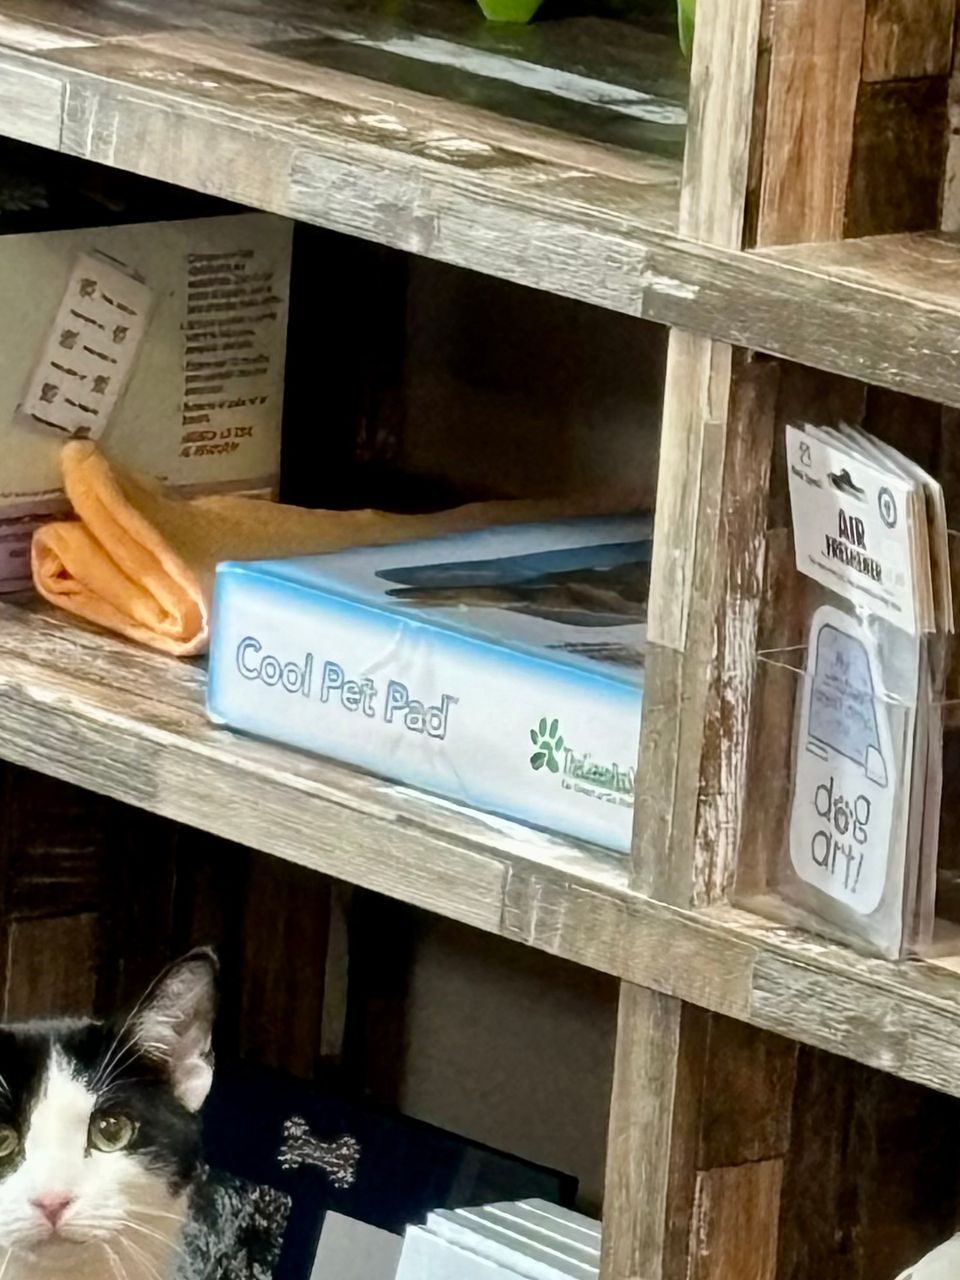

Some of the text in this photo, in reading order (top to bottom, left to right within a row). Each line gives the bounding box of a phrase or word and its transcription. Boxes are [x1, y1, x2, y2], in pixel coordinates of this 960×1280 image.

[838, 507, 867, 551] AIR
[235, 636, 450, 741] Cool Pet Pad
[814, 776, 871, 844] dog
